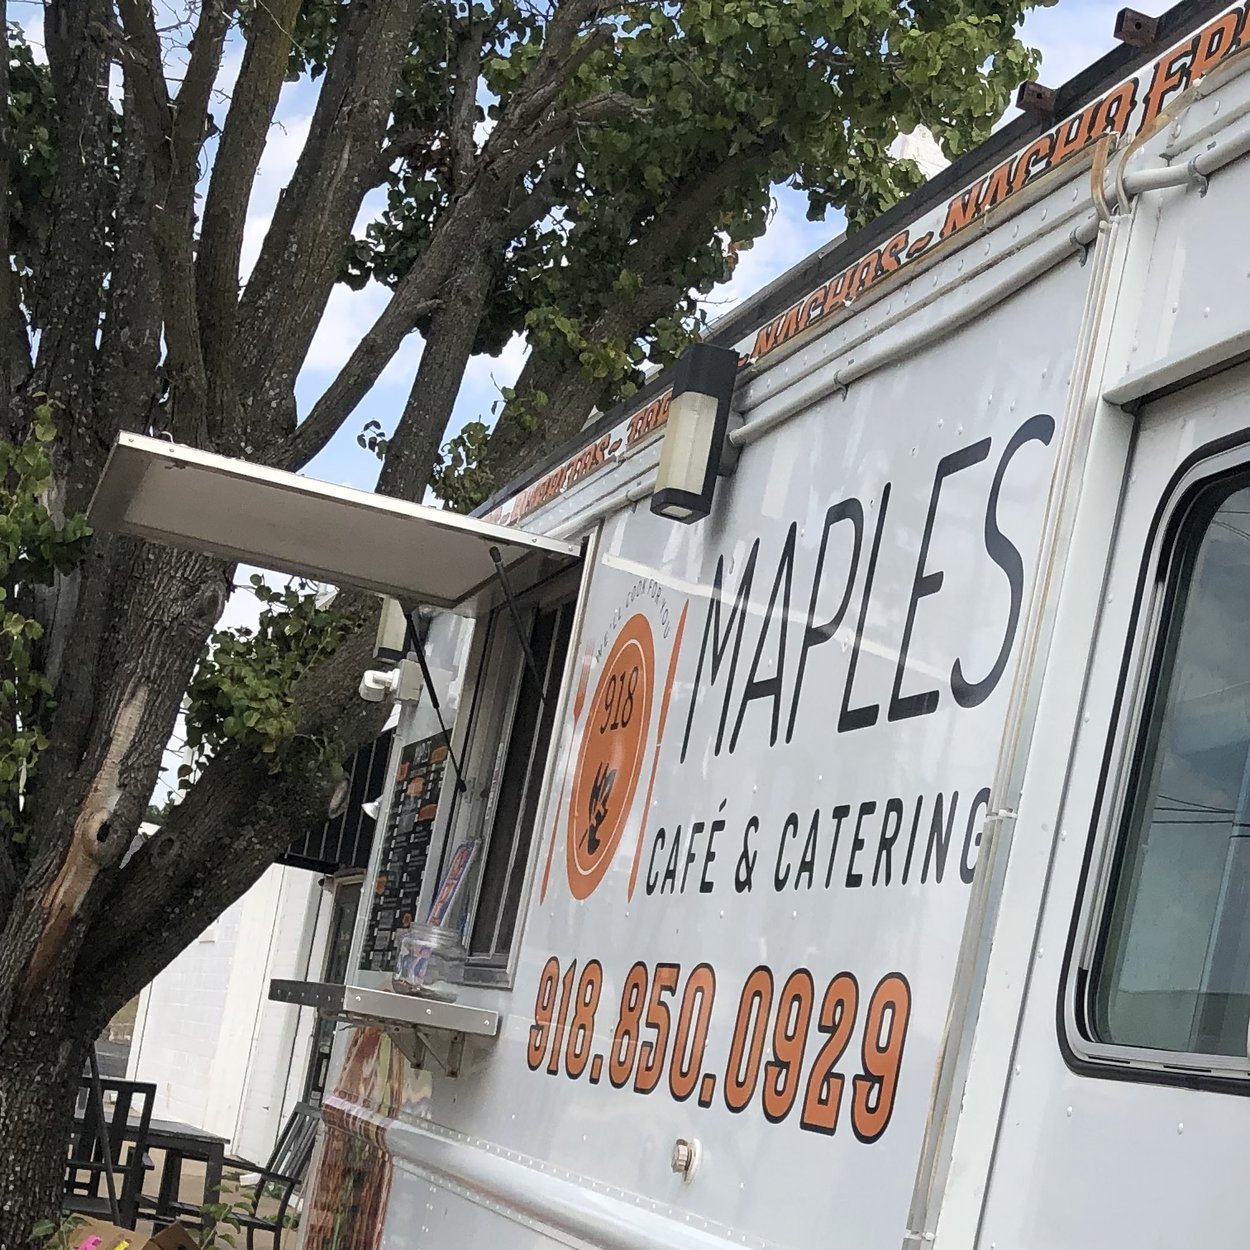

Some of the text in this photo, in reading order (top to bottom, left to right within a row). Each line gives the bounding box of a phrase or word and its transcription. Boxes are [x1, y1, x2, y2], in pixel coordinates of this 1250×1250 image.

[751, 230, 909, 360] NACHOS
[939, 77, 1139, 238] NACHO
[680, 414, 1056, 764] MAPLES
[600, 665, 639, 735] 918
[646, 786, 991, 896] CAFÉ & CATERING
[526, 955, 912, 1145] 918.850.0929
